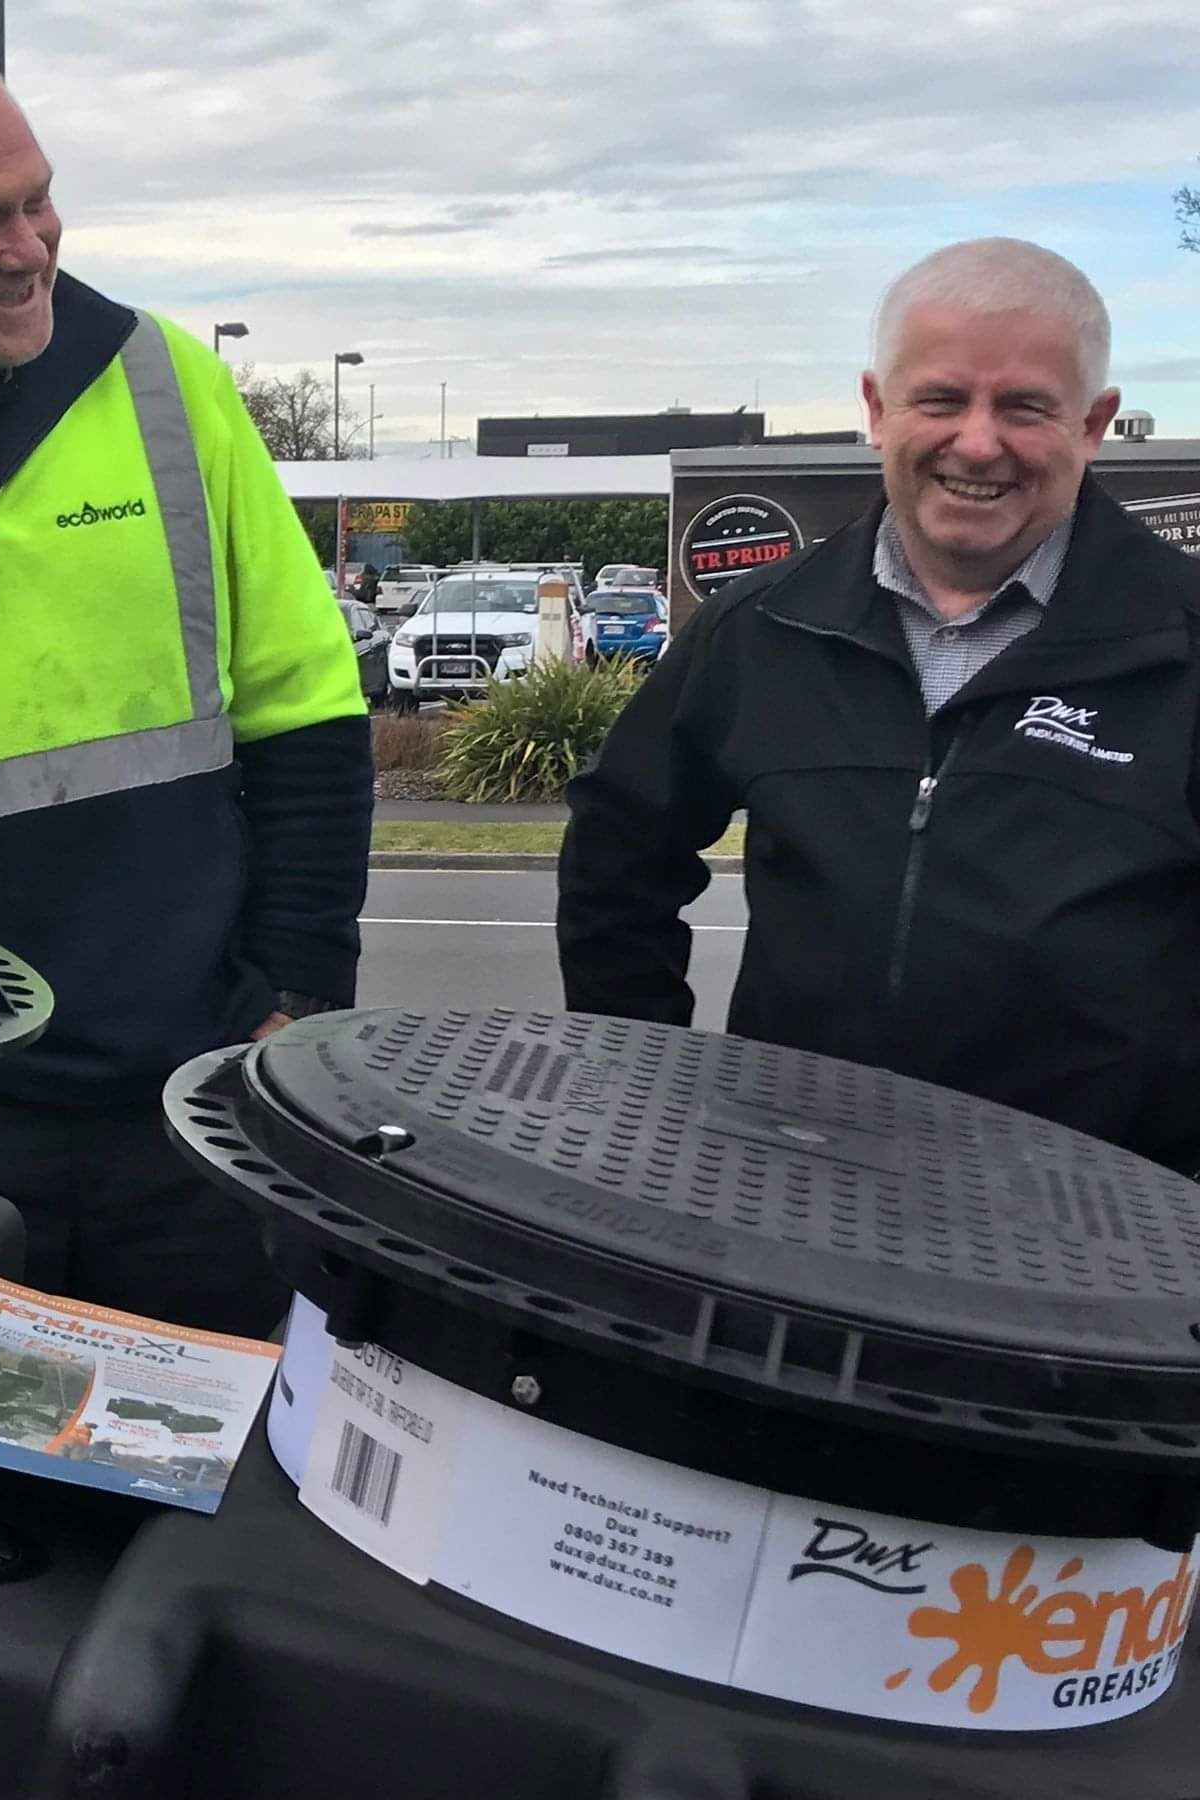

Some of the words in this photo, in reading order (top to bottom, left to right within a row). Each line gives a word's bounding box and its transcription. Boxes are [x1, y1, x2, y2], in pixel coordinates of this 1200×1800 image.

[726, 542, 791, 566] PRIDE
[1152, 527, 1184, 541] OR
[1023, 696, 1098, 726] Dux
[32, 1324, 114, 1351] Grease
[121, 1347, 175, 1364] Trap
[528, 1469, 568, 1495] Need
[572, 1485, 649, 1521] Technical
[651, 1512, 732, 1544] Support?
[605, 1516, 638, 1538] Dux
[553, 1539, 678, 1589] dux@dux.co.nz
[564, 1523, 604, 1546] 0800
[607, 1537, 640, 1557] 367
[642, 1548, 674, 1568] 389
[803, 1517, 932, 1575] Dux
[550, 1558, 674, 1608] www.dux.co.nz
[1052, 1656, 1164, 1708] GREASE
